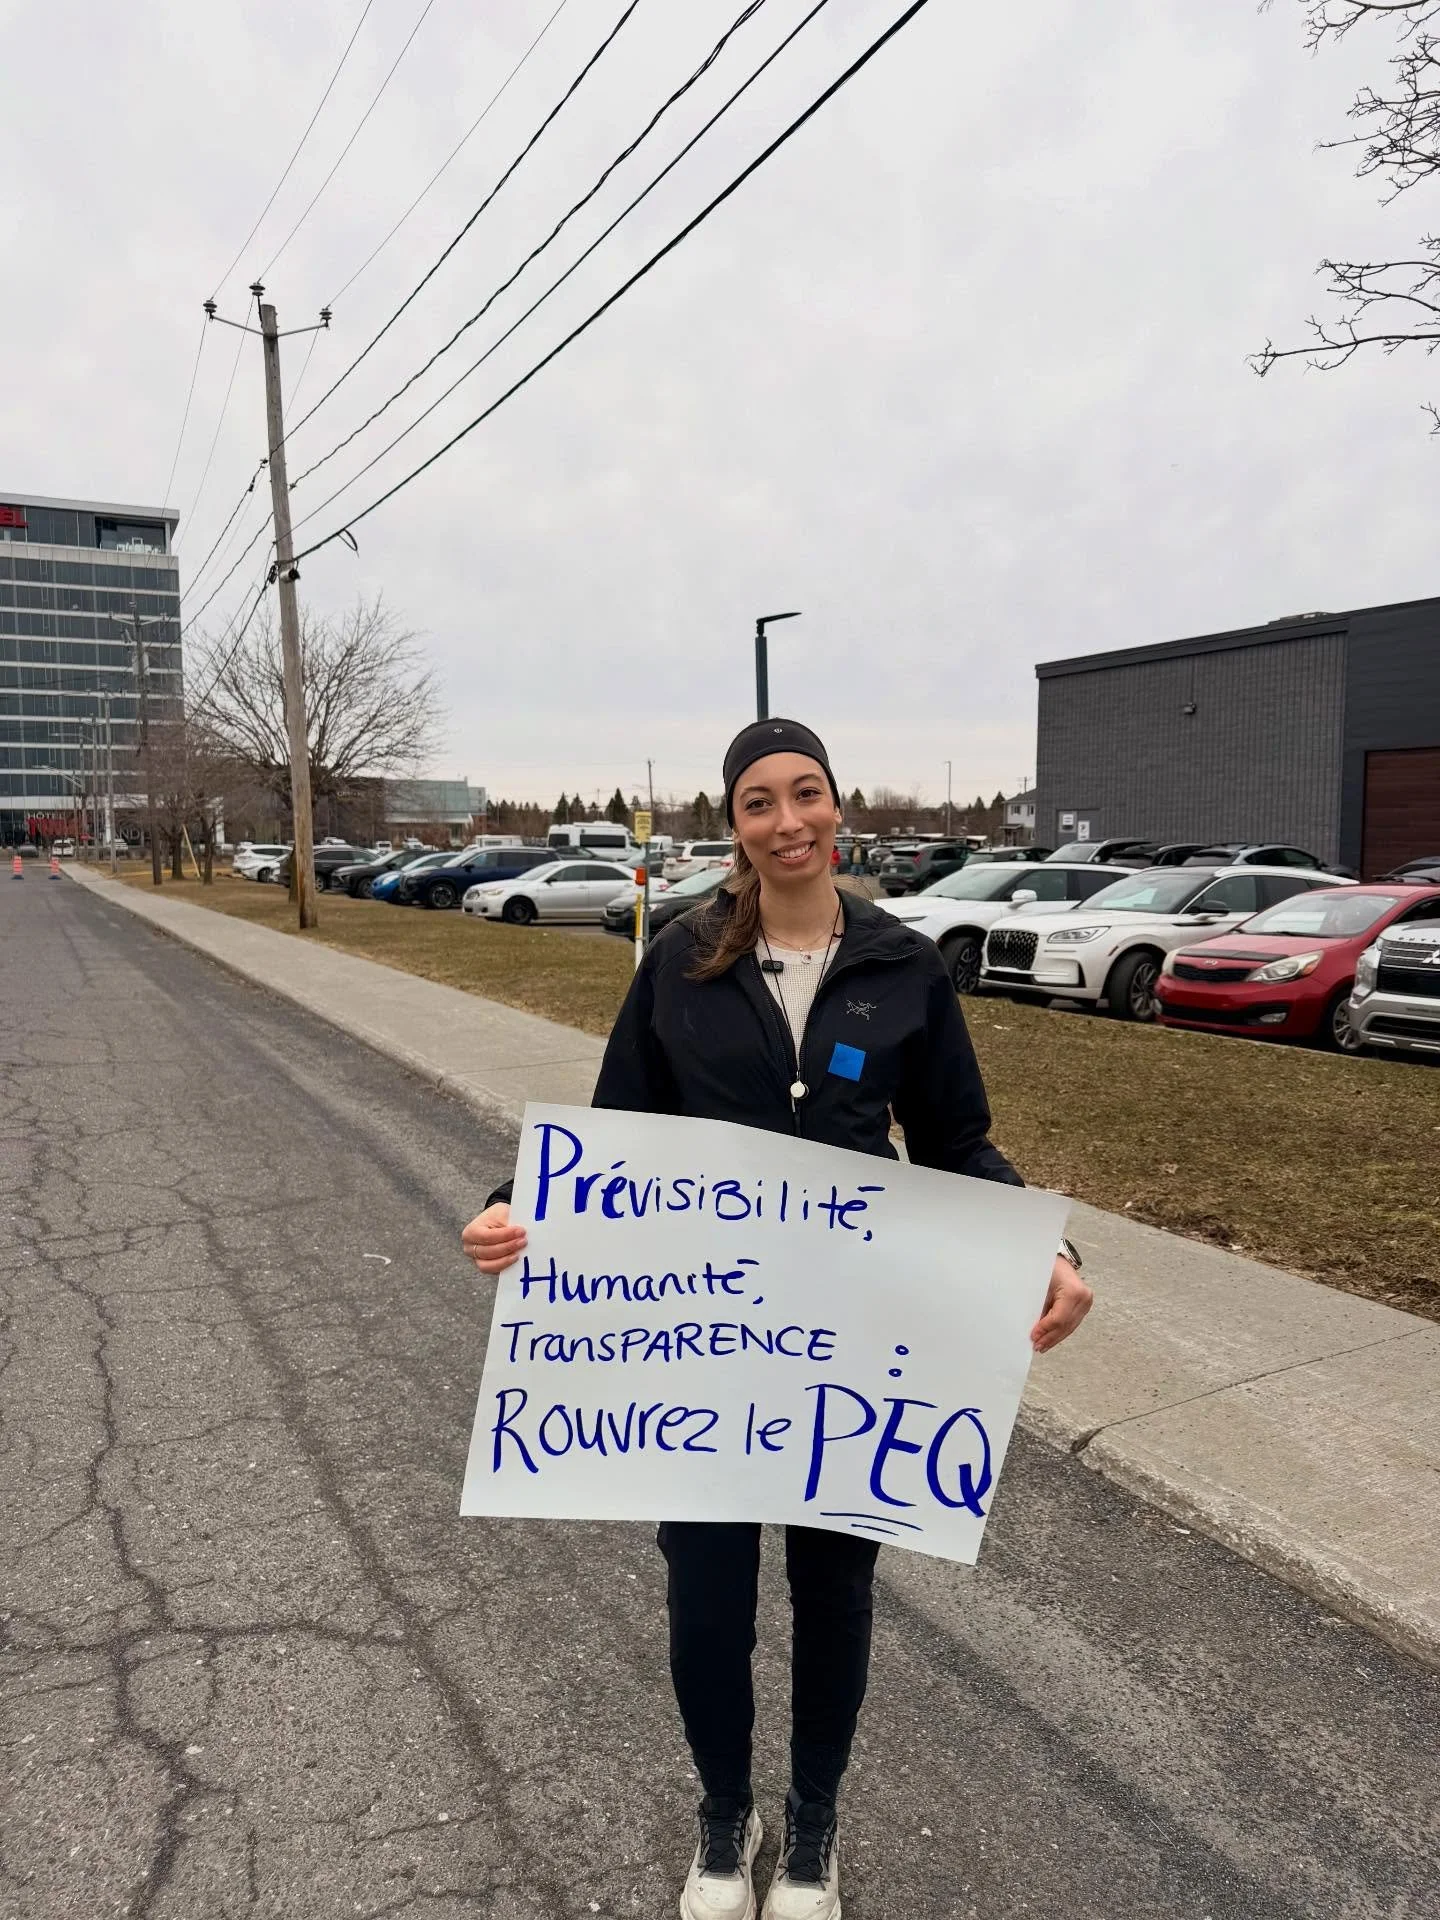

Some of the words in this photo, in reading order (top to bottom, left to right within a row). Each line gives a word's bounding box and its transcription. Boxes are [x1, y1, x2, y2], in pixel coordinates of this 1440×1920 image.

[520, 1257, 765, 1305] Humanité,
[491, 1388, 720, 1474] Rouvrez
[745, 1403, 793, 1456] le
[803, 1383, 993, 1519] PEQ
